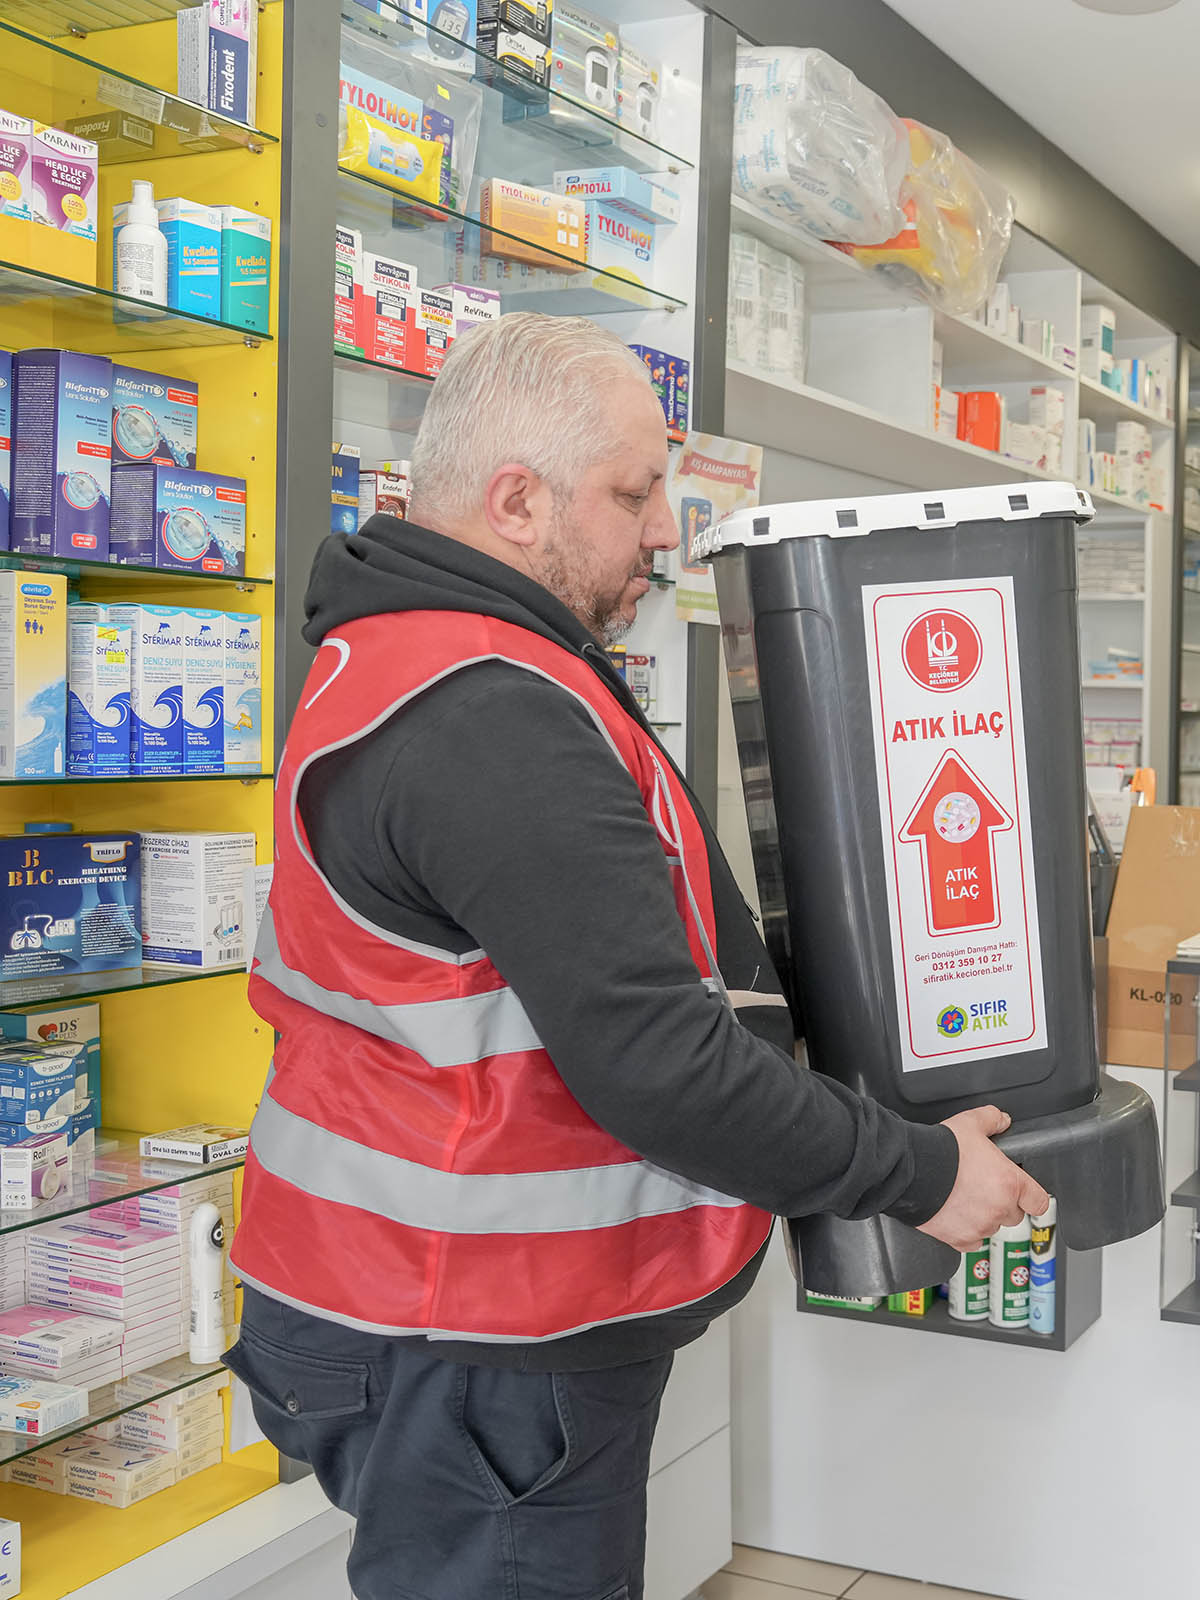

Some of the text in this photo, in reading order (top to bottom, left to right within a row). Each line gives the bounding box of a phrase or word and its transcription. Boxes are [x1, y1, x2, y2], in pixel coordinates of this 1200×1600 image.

[220, 49, 236, 112] Fixodent
[43, 132, 88, 155] PARANIT
[45, 159, 87, 180] HEAD LICE
[61, 172, 82, 185] EGGS
[598, 214, 653, 250] TYLOLHOT
[464, 305, 493, 320] ReVitex
[892, 709, 1005, 743] ATIK İLAÇ
[8, 869, 54, 887] BLC
[58, 874, 127, 885] EXERCISE DEVICE
[82, 866, 127, 875] BREATHING
[945, 866, 978, 884] ATIK
[946, 883, 980, 901] İLAÇ
[914, 952, 930, 962] Geri
[931, 949, 966, 960] Dönüşüm
[967, 944, 998, 954] Danışma
[932, 953, 1002, 972] 0312 359 10 27
[923, 964, 1013, 985] sifiratik.kecioren.bel.tr
[970, 999, 1008, 1017] SIFIR
[59, 1019, 78, 1034] DS
[973, 1012, 1008, 1032] ATIK
[212, 1150, 232, 1159] OVAL
